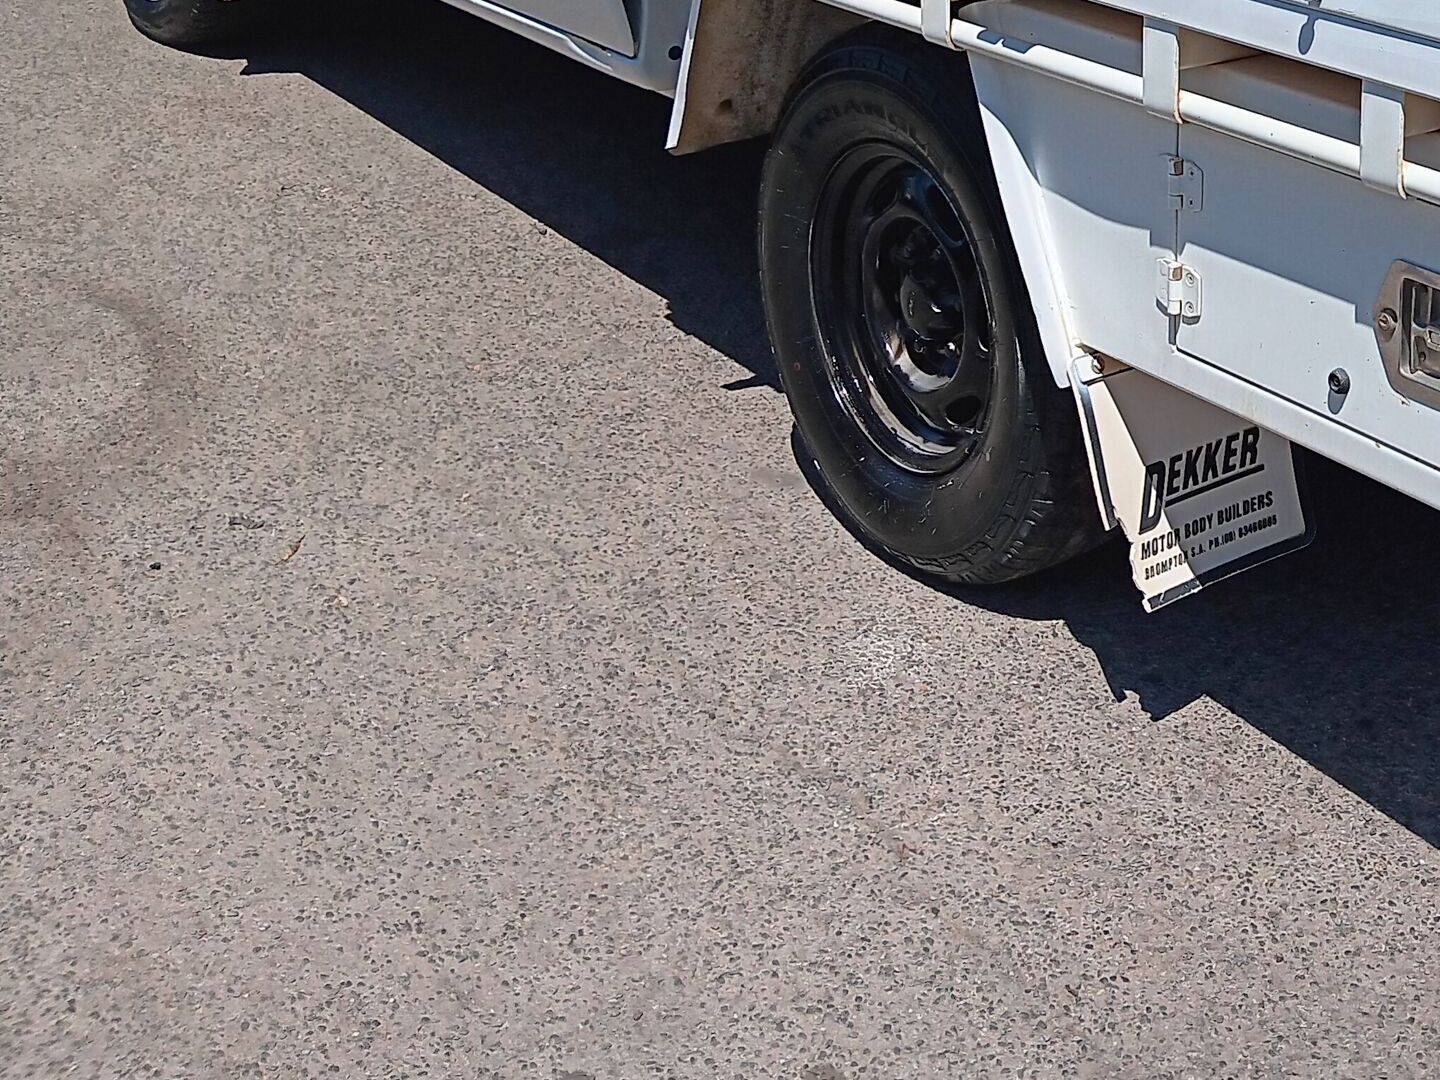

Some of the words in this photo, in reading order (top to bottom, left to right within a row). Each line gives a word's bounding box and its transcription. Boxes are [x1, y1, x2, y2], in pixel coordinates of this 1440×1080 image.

[1139, 425, 1261, 534] DEKKER
[1140, 527, 1181, 560] MOTOR
[1184, 513, 1214, 540] BODY
[1217, 491, 1274, 526] BUILDERS
[1144, 550, 1189, 580] BROMPTON
[1191, 545, 1206, 558] S.A.
